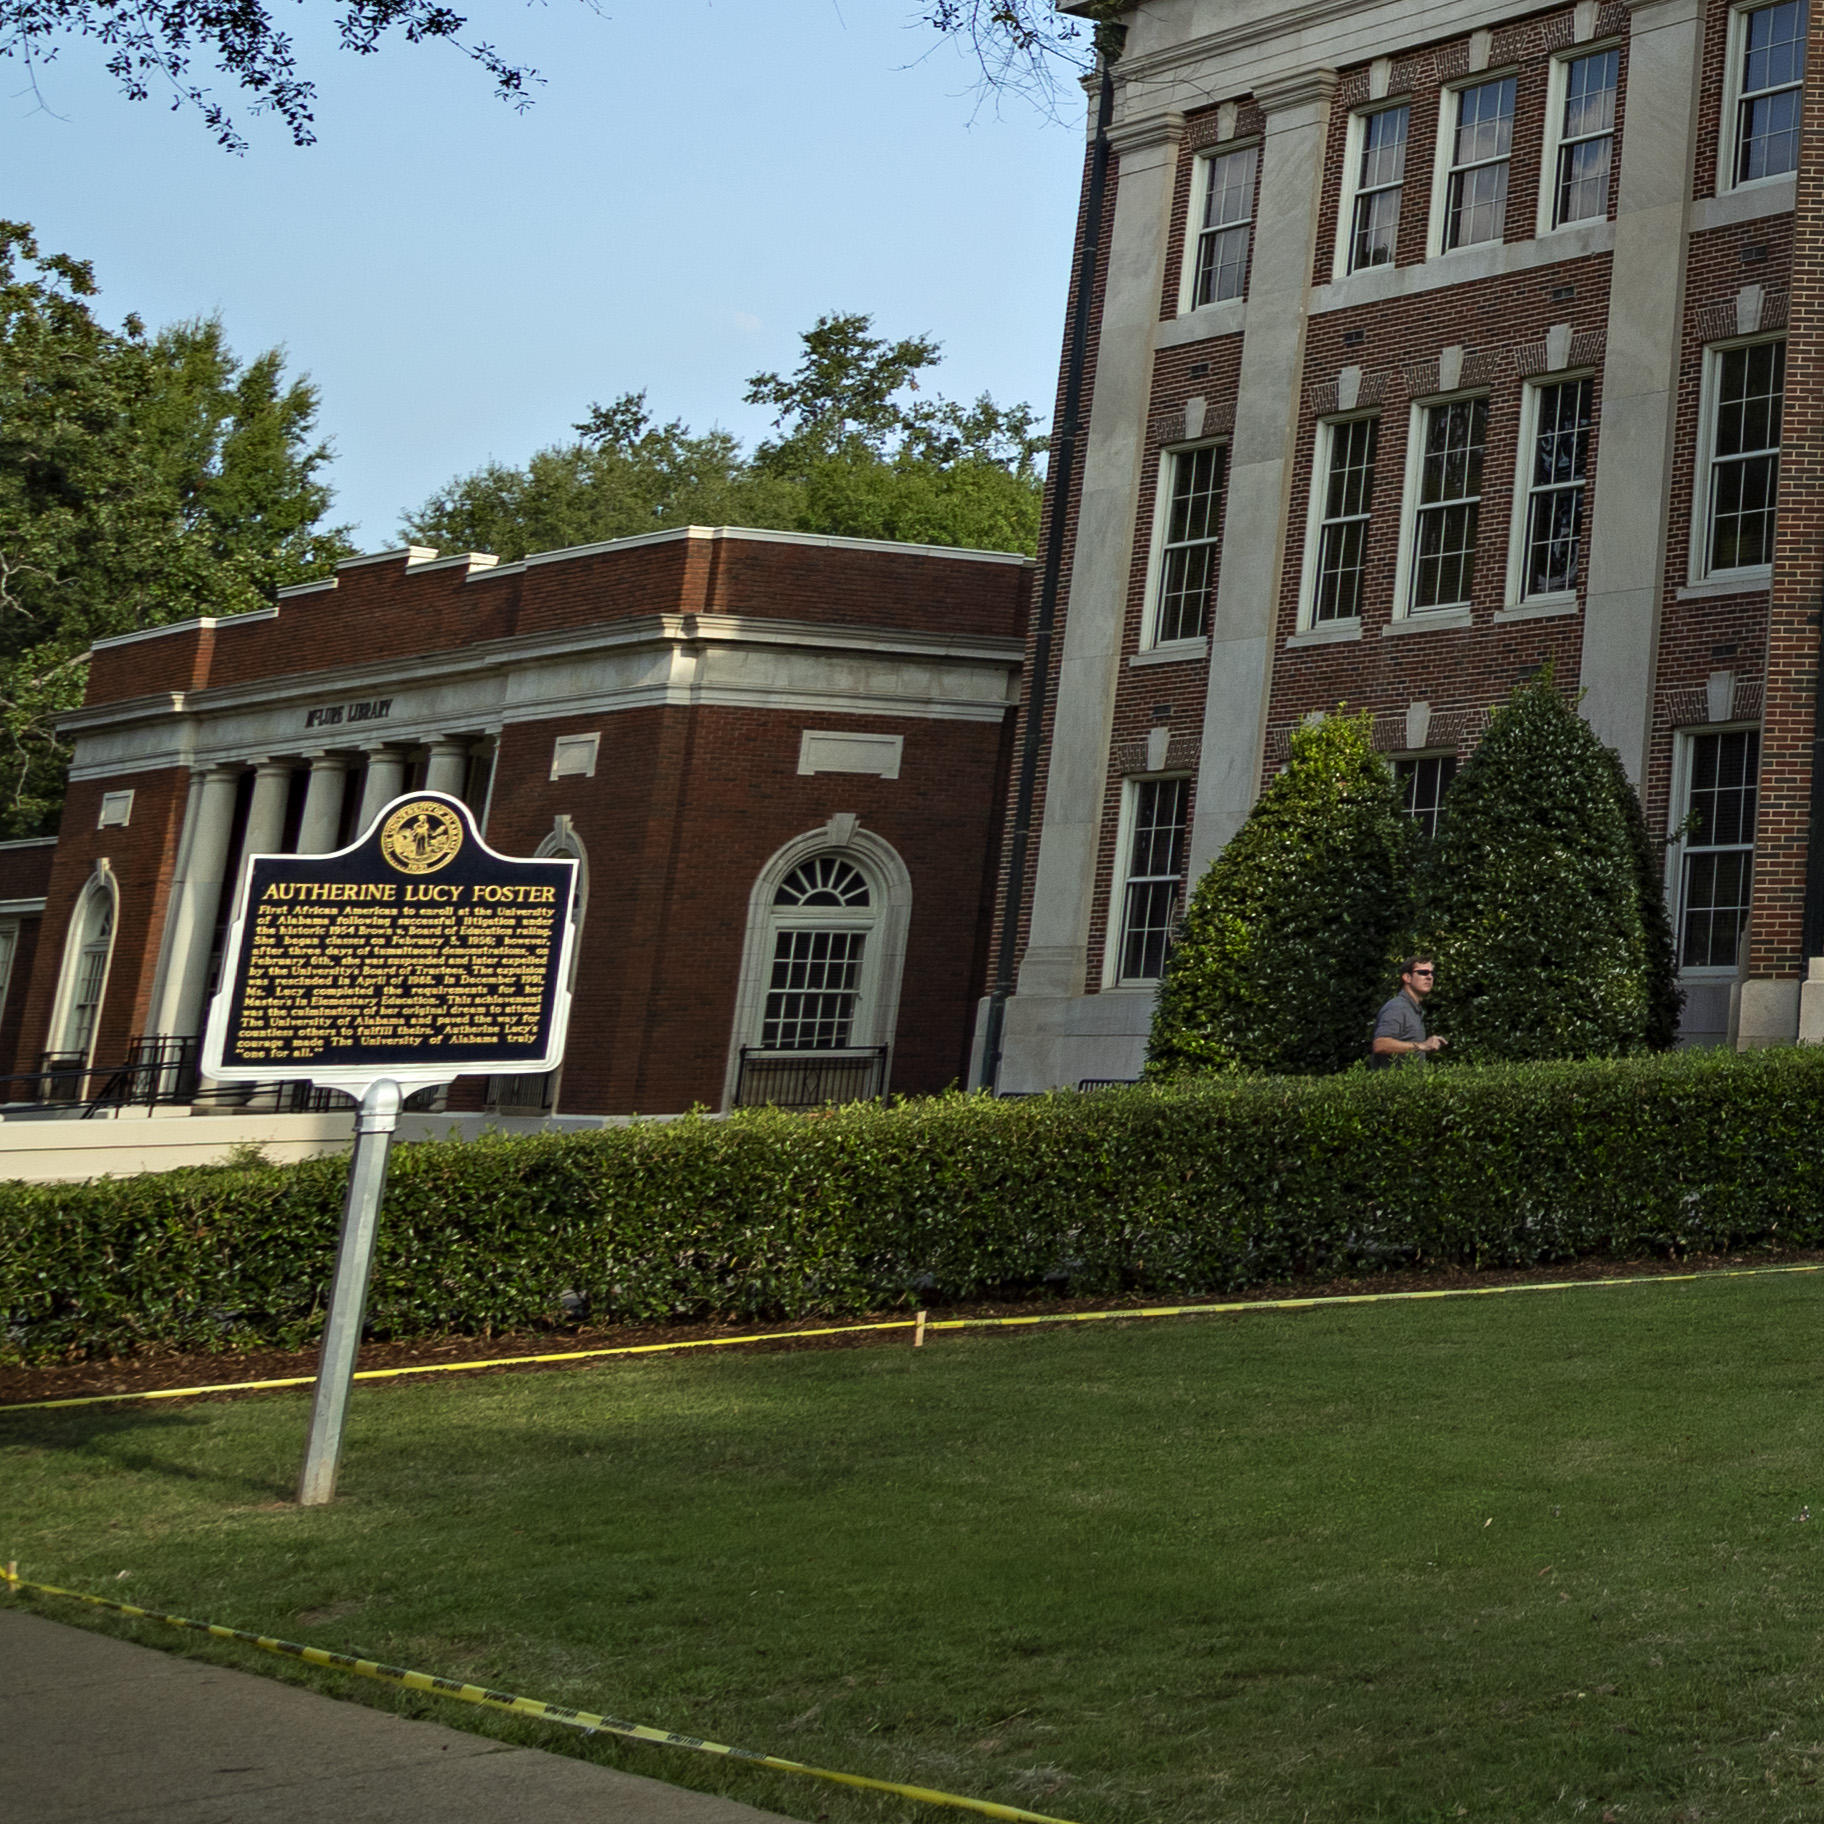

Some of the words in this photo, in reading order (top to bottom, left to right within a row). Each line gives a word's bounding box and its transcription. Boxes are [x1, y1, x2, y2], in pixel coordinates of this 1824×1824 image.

[260, 883, 397, 901] AUTHERINE
[403, 885, 463, 902] LUCY
[471, 886, 557, 903] FOSTER
